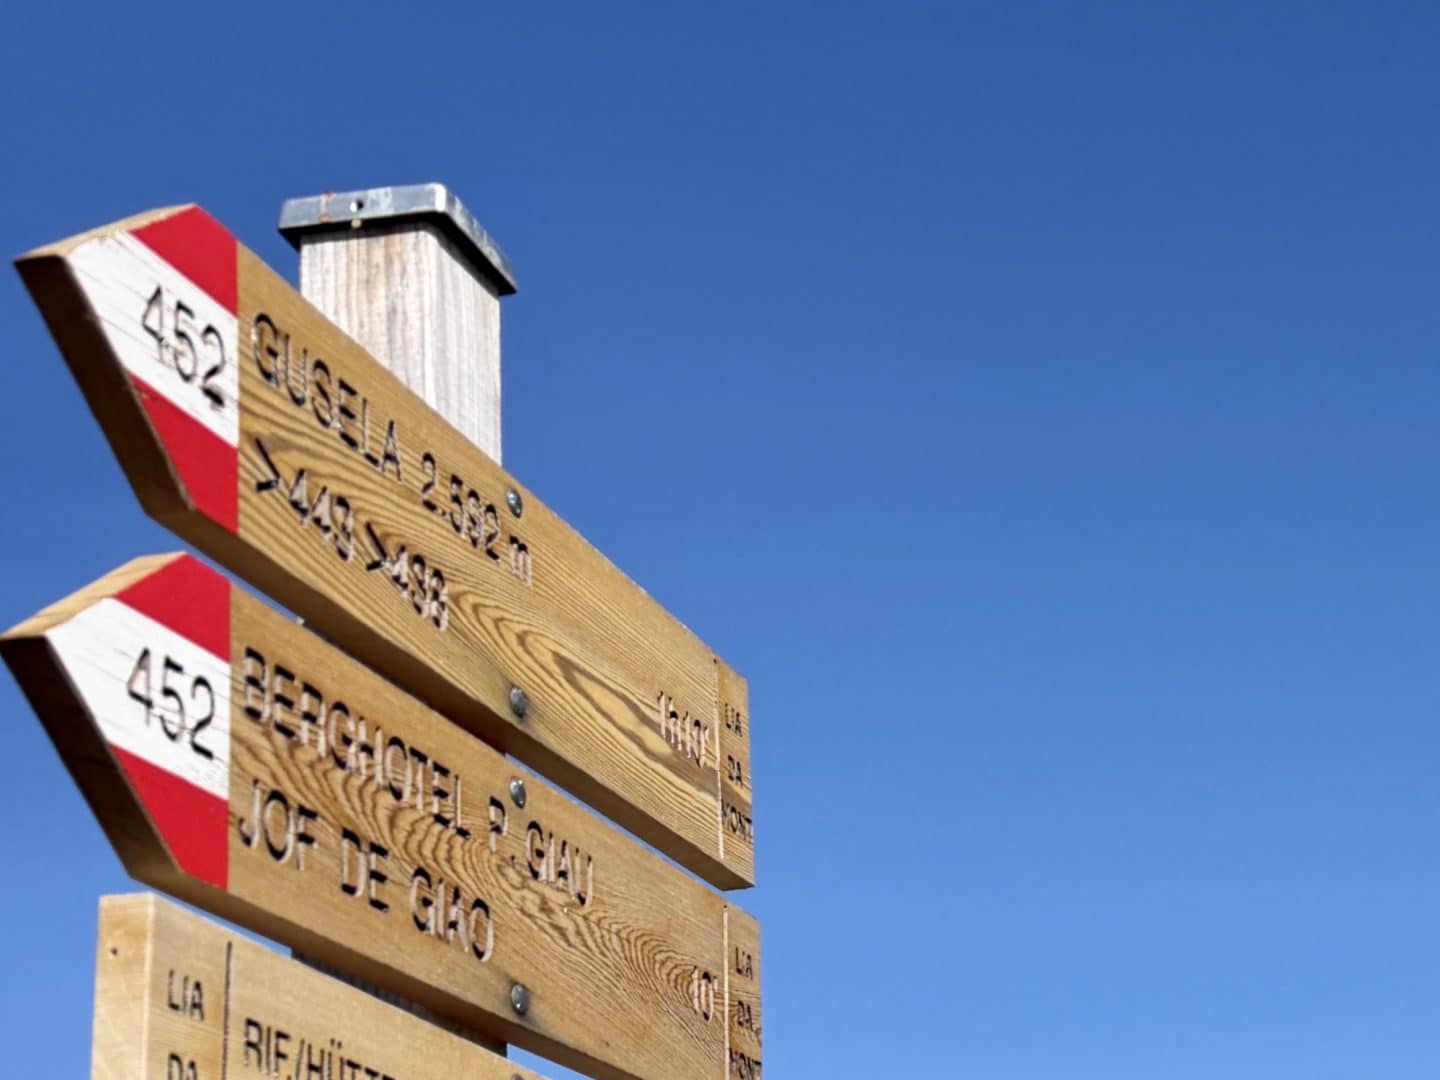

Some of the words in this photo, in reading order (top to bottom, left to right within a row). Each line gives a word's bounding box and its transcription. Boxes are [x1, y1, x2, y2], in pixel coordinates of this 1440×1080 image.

[141, 286, 225, 408] 452
[251, 313, 401, 482] GUSELA
[126, 647, 215, 761] 452
[243, 646, 471, 841] BERGHOTEL
[525, 820, 594, 907] GIAU
[728, 755, 743, 787] DA
[239, 778, 318, 870] JOF
[340, 827, 389, 913] DE
[167, 969, 204, 1022] LIA
